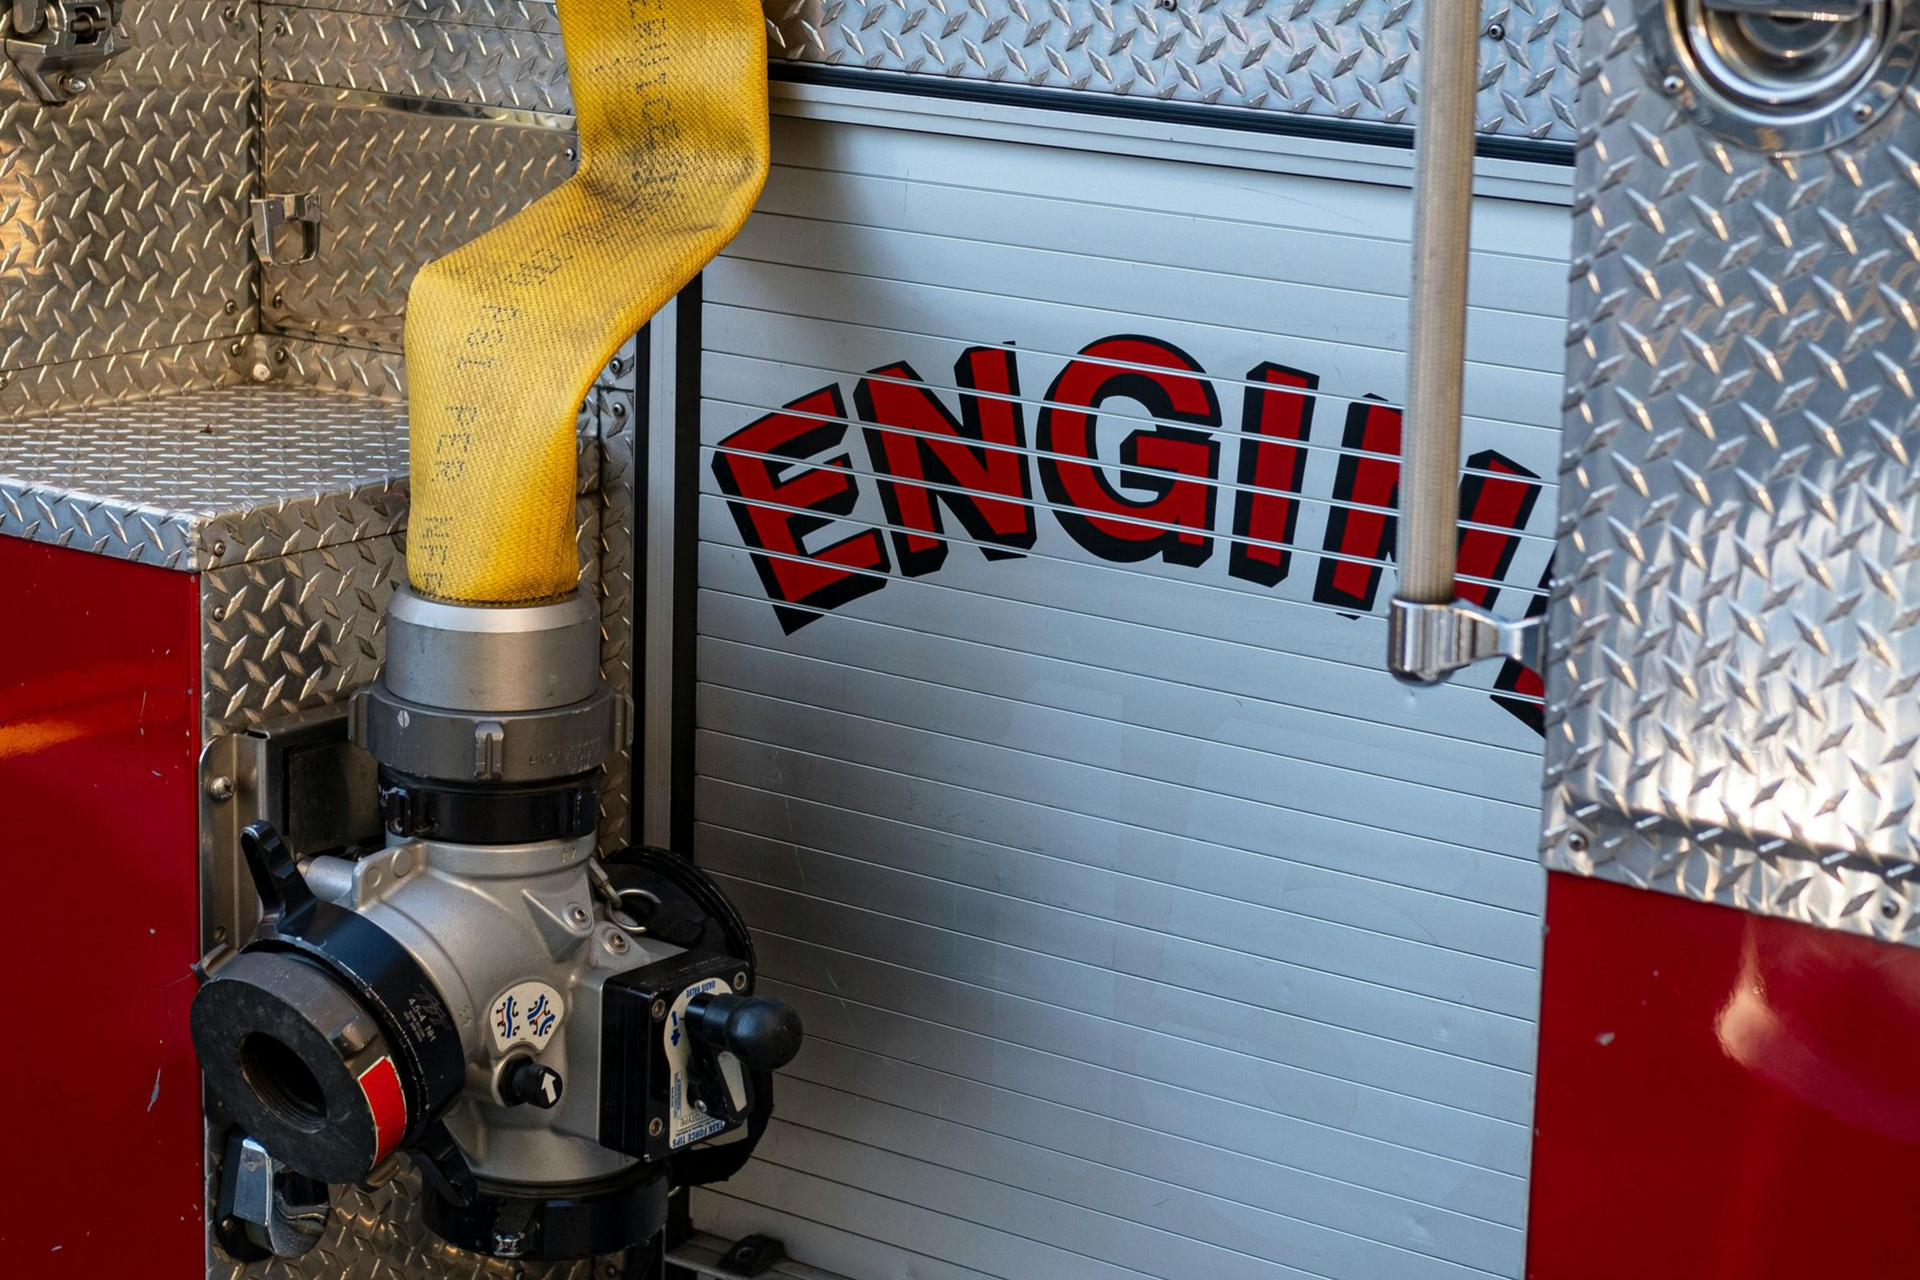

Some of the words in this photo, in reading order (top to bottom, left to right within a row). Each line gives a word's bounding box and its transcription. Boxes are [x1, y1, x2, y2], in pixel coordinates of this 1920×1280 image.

[711, 334, 1556, 740] ENGIN
[708, 1120, 723, 1133] TASK
[687, 1127, 708, 1142] FORCE
[672, 1136, 686, 1148] TIPS
